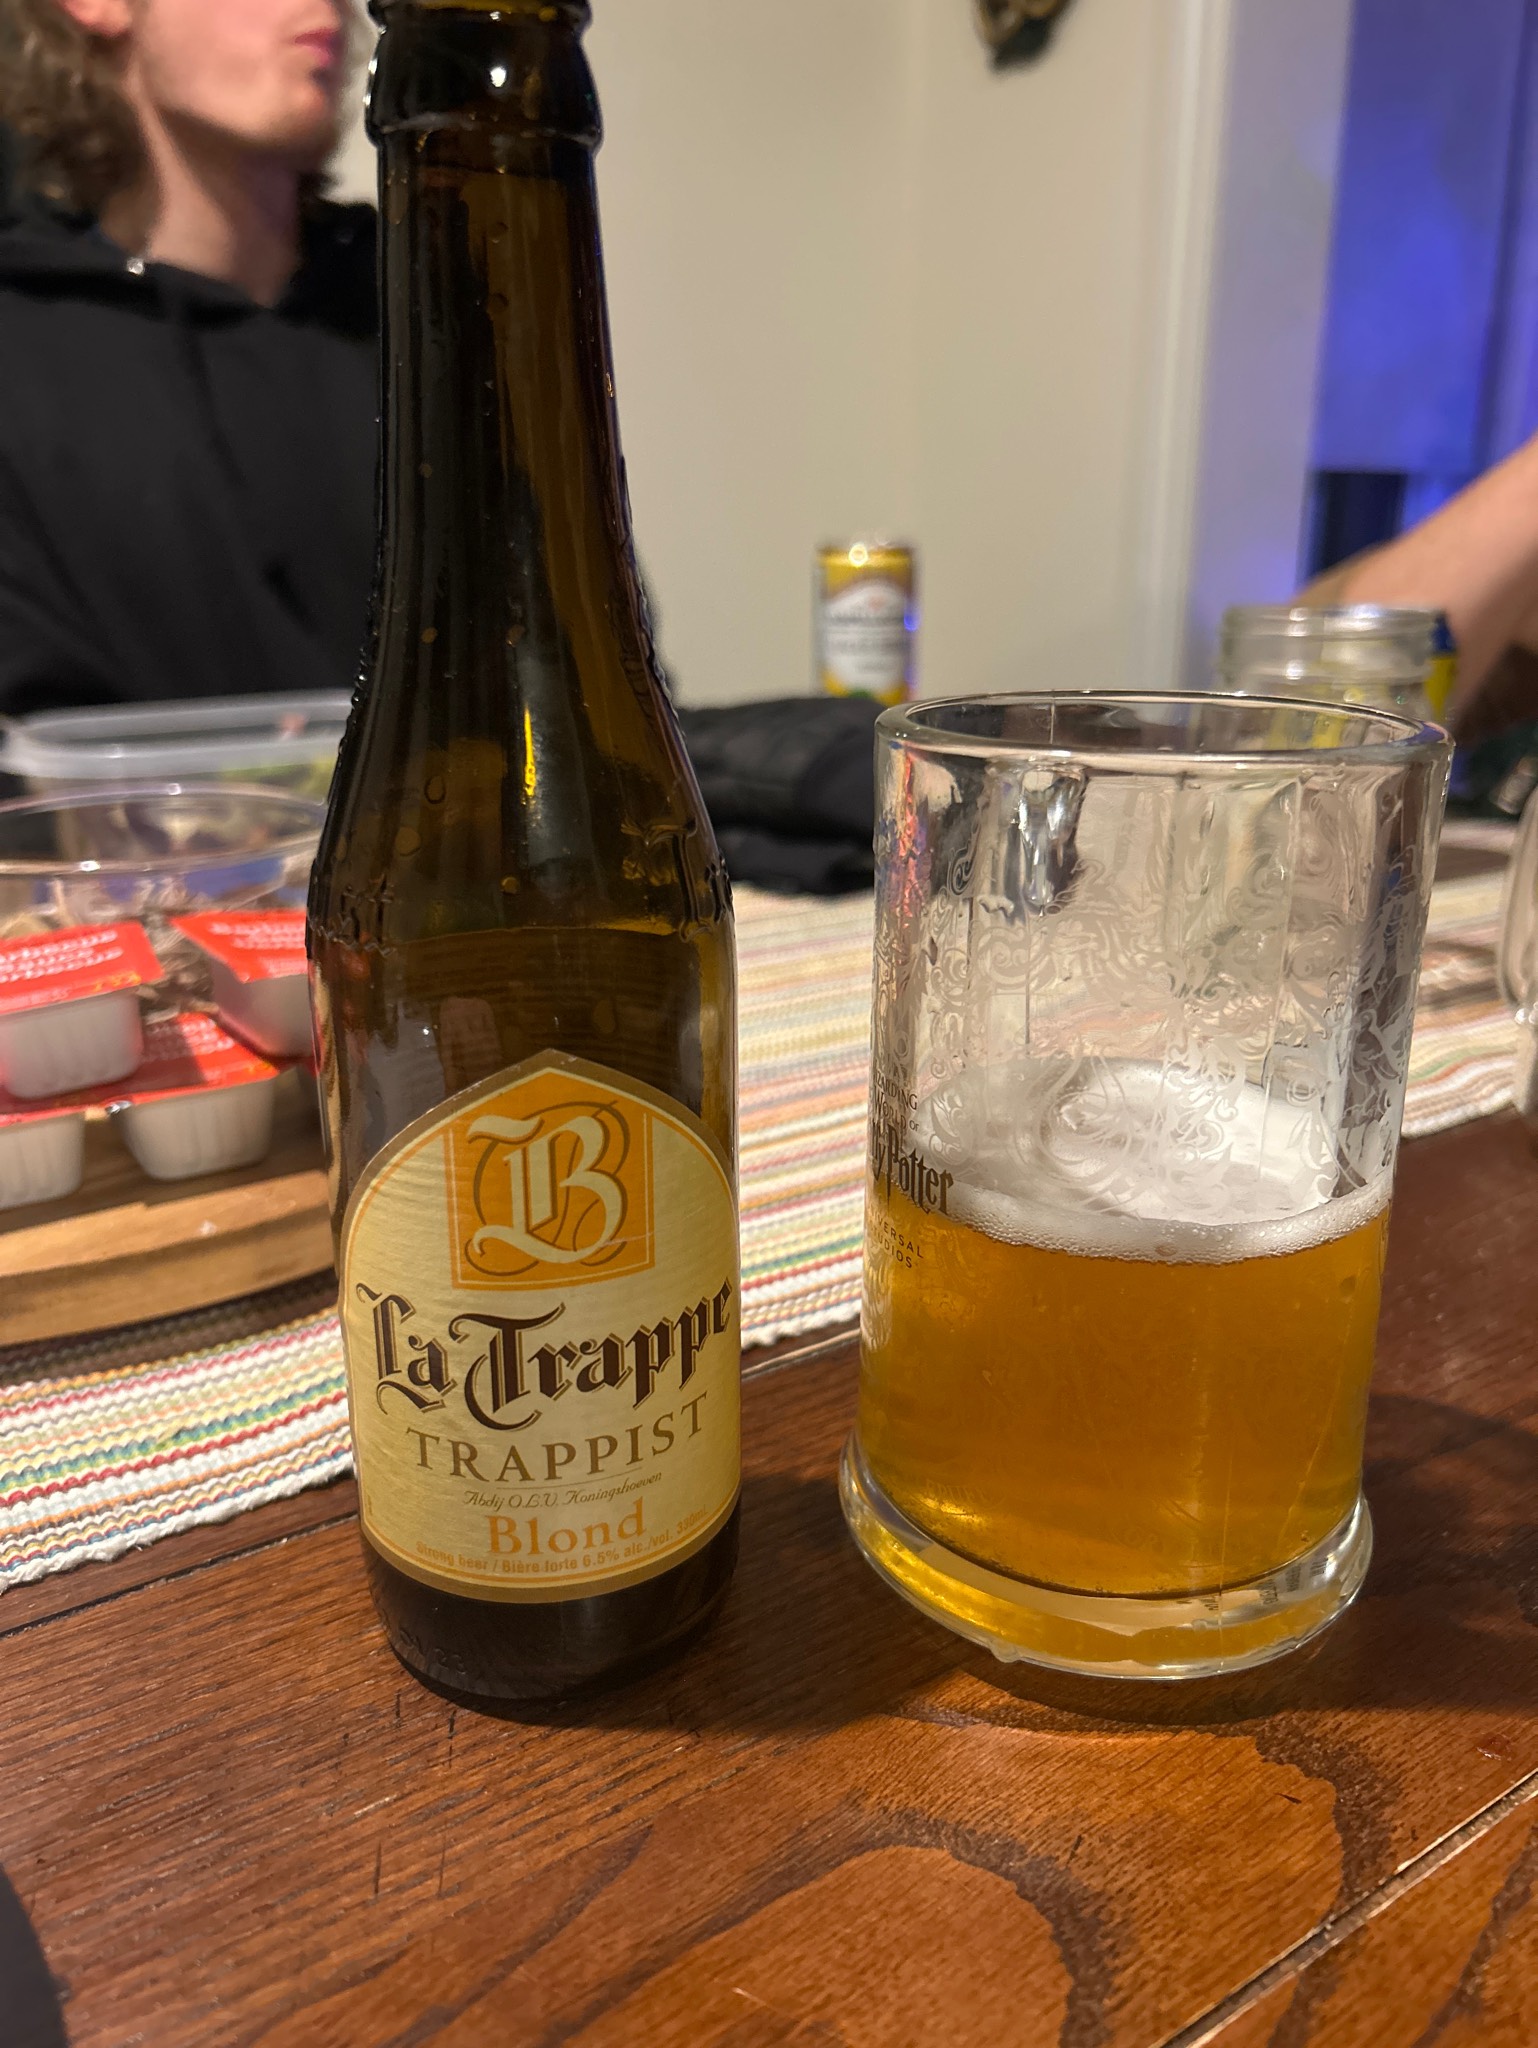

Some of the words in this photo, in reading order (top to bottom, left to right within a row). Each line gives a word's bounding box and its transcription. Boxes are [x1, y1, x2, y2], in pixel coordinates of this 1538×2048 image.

[886, 1123, 954, 1216] Potter
[356, 1283, 457, 1415] La
[448, 1277, 732, 1431] Trappe
[405, 1392, 708, 1483] TRAPPIST
[464, 1490, 504, 1512] Abdij
[485, 1496, 647, 1556] Blond
[415, 1541, 455, 1567] Strong
[458, 1554, 489, 1570] beer
[502, 1559, 540, 1573] Bière
[543, 1557, 577, 1573] forte
[583, 1549, 620, 1568] 6.5%
